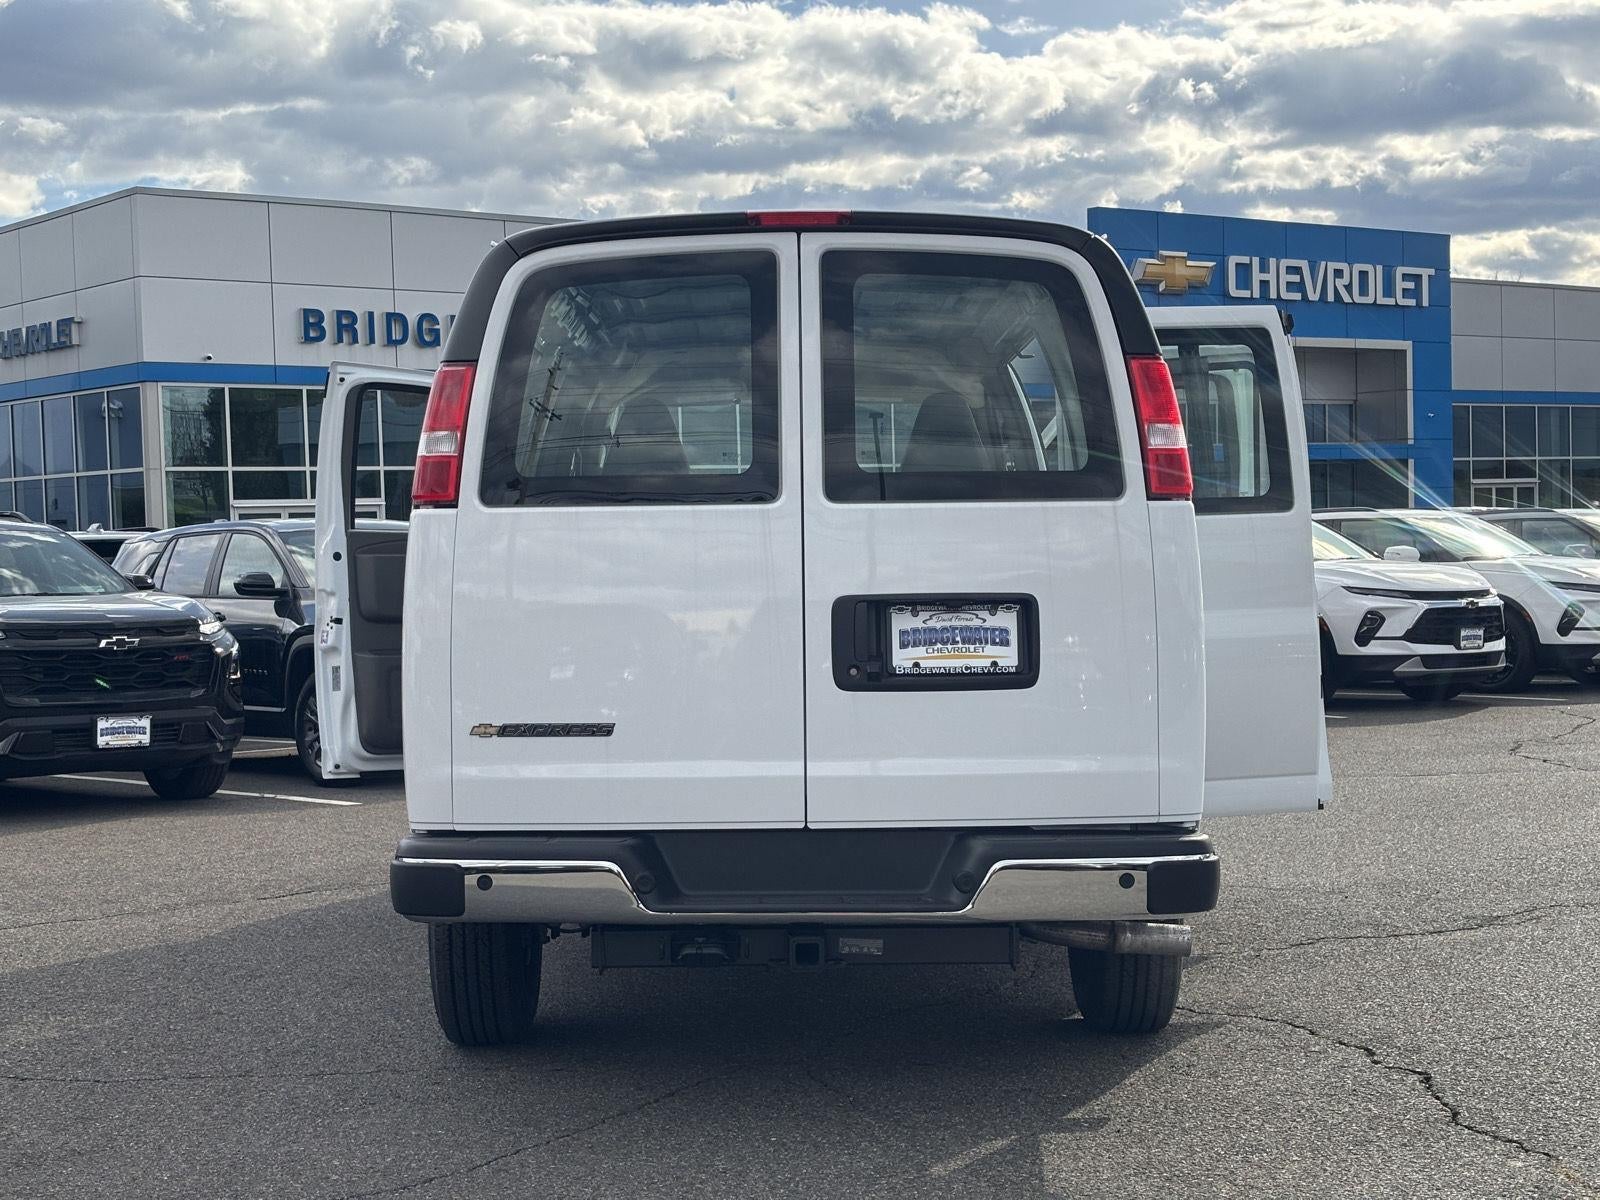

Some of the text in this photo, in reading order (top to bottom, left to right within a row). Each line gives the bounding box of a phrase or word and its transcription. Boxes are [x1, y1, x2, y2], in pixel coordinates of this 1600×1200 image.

[1227, 255, 1436, 307] CHEVROLET
[0, 316, 79, 359] HEVROLET
[299, 308, 457, 347] BRIDG
[899, 625, 1011, 649] BRIDGEWATER
[925, 646, 986, 654] CHEVROLET
[499, 723, 616, 737] EXPRESS
